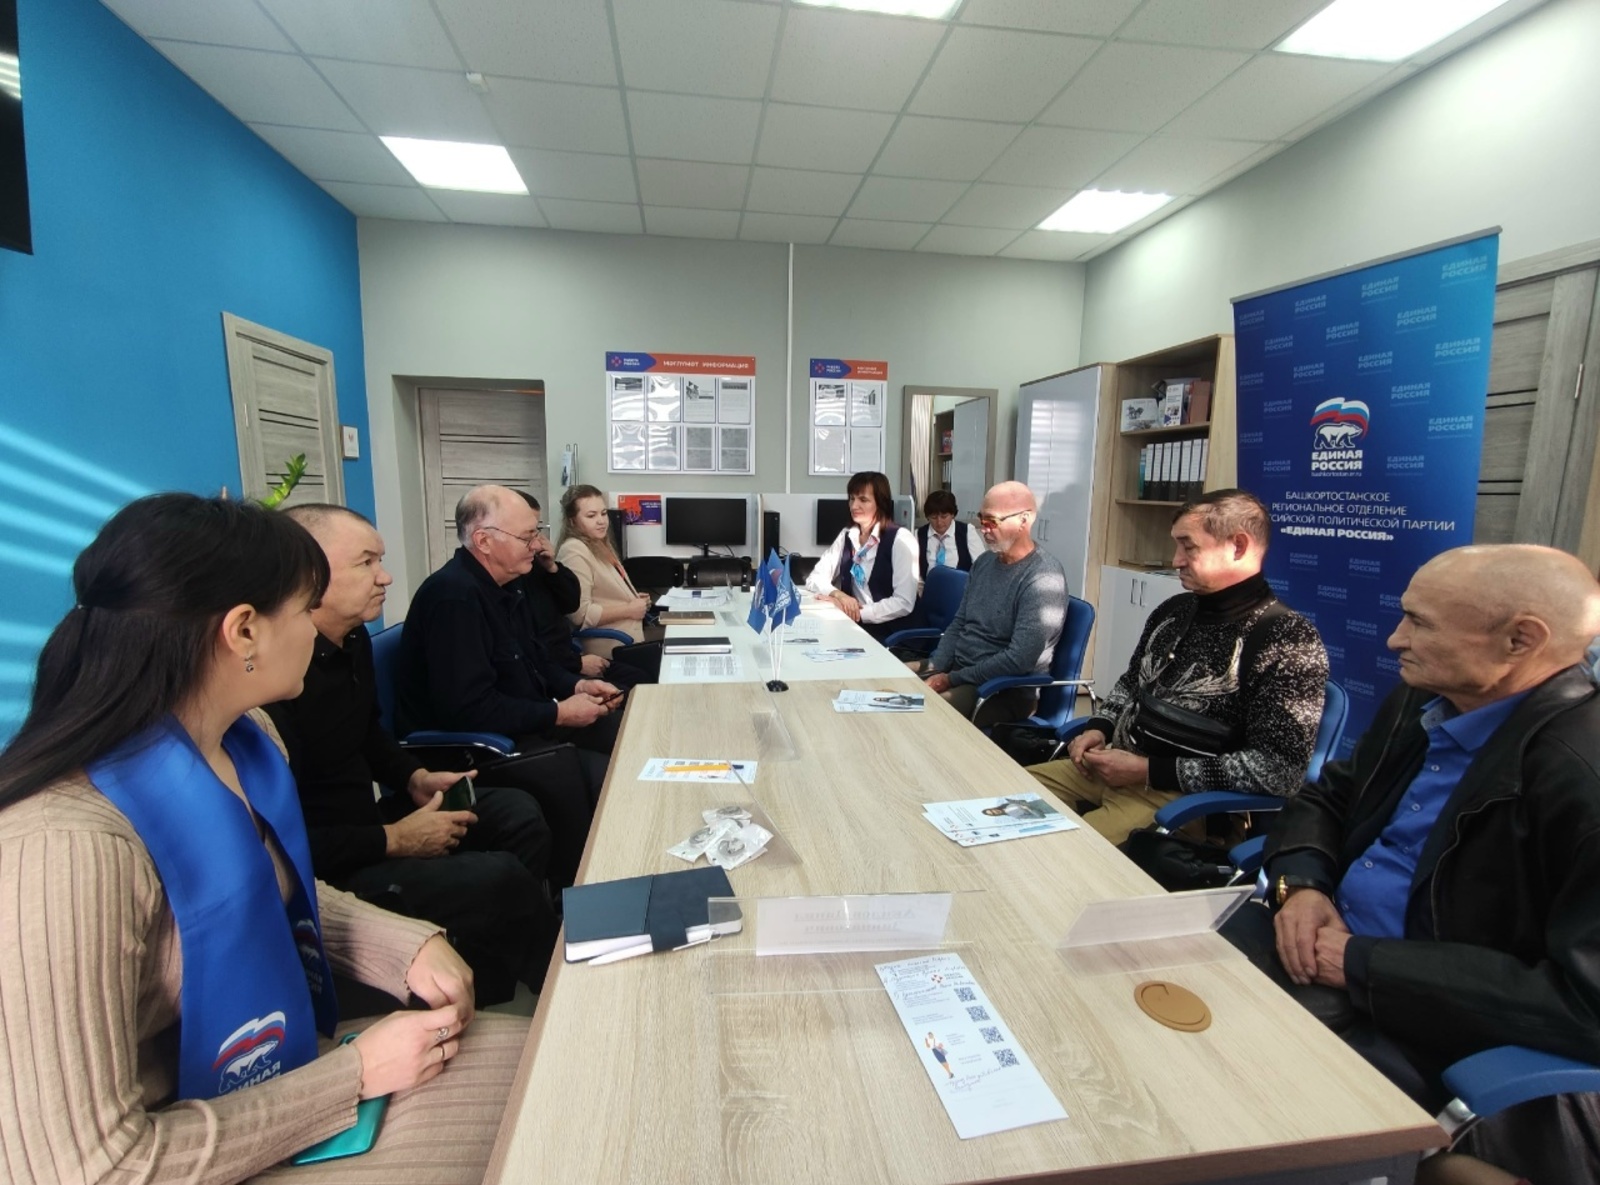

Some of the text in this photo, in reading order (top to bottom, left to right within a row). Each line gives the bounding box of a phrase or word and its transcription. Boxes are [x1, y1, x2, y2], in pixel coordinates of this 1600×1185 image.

[1442, 256, 1487, 271] ЕДИНАЯ
[1441, 264, 1487, 280] РОССИЯ
[1361, 276, 1399, 291] ЕДИНАЯ
[1361, 284, 1398, 298] РОССИЯ
[1294, 295, 1327, 307] ЕДИНАЯ
[1294, 301, 1326, 313] РОССИЯ
[1397, 306, 1437, 319] ЕДИНАЯ
[1396, 313, 1437, 327] РОССИЯ
[1326, 321, 1359, 334] ЕДИНАЯ
[1326, 329, 1359, 340] РОССИЯ
[1435, 337, 1480, 350] ЕДИНАЯ
[1358, 351, 1393, 362] ЕДИНАЯ
[1435, 345, 1480, 358] РОССИЯ
[1294, 362, 1325, 372] ЕДИНАЯ
[1358, 359, 1392, 369] РОССИЯ
[1293, 369, 1325, 379] РОССИЯ
[1391, 382, 1430, 392] ЕДИНАЯ
[1391, 390, 1430, 399] РОССИЯ
[1429, 415, 1473, 425] ЕДИНАЯ
[1429, 423, 1473, 432] РОССИЯ
[1311, 450, 1363, 461] ЕДИНАЯ
[1387, 455, 1424, 463] ЕДИНАЯ
[1311, 460, 1362, 471] РОССИЯ
[1286, 491, 1391, 502] БАШКОРТОСТАНСКОЕ
[1271, 502, 1408, 516] РЕГИОНАЛЬНОЕ ОТДЕЛЕНИЕ
[1269, 512, 1455, 531] СИЙСКОЙ ПОЛИТИЧЕСКОЙ ПАРТИИ
[1280, 526, 1394, 541] «ЕДИНАЯ РОССИЯ»
[1349, 565, 1380, 573] РОССИЯ
[1380, 593, 1401, 602] ЕДИН
[1380, 600, 1402, 609] РОСС
